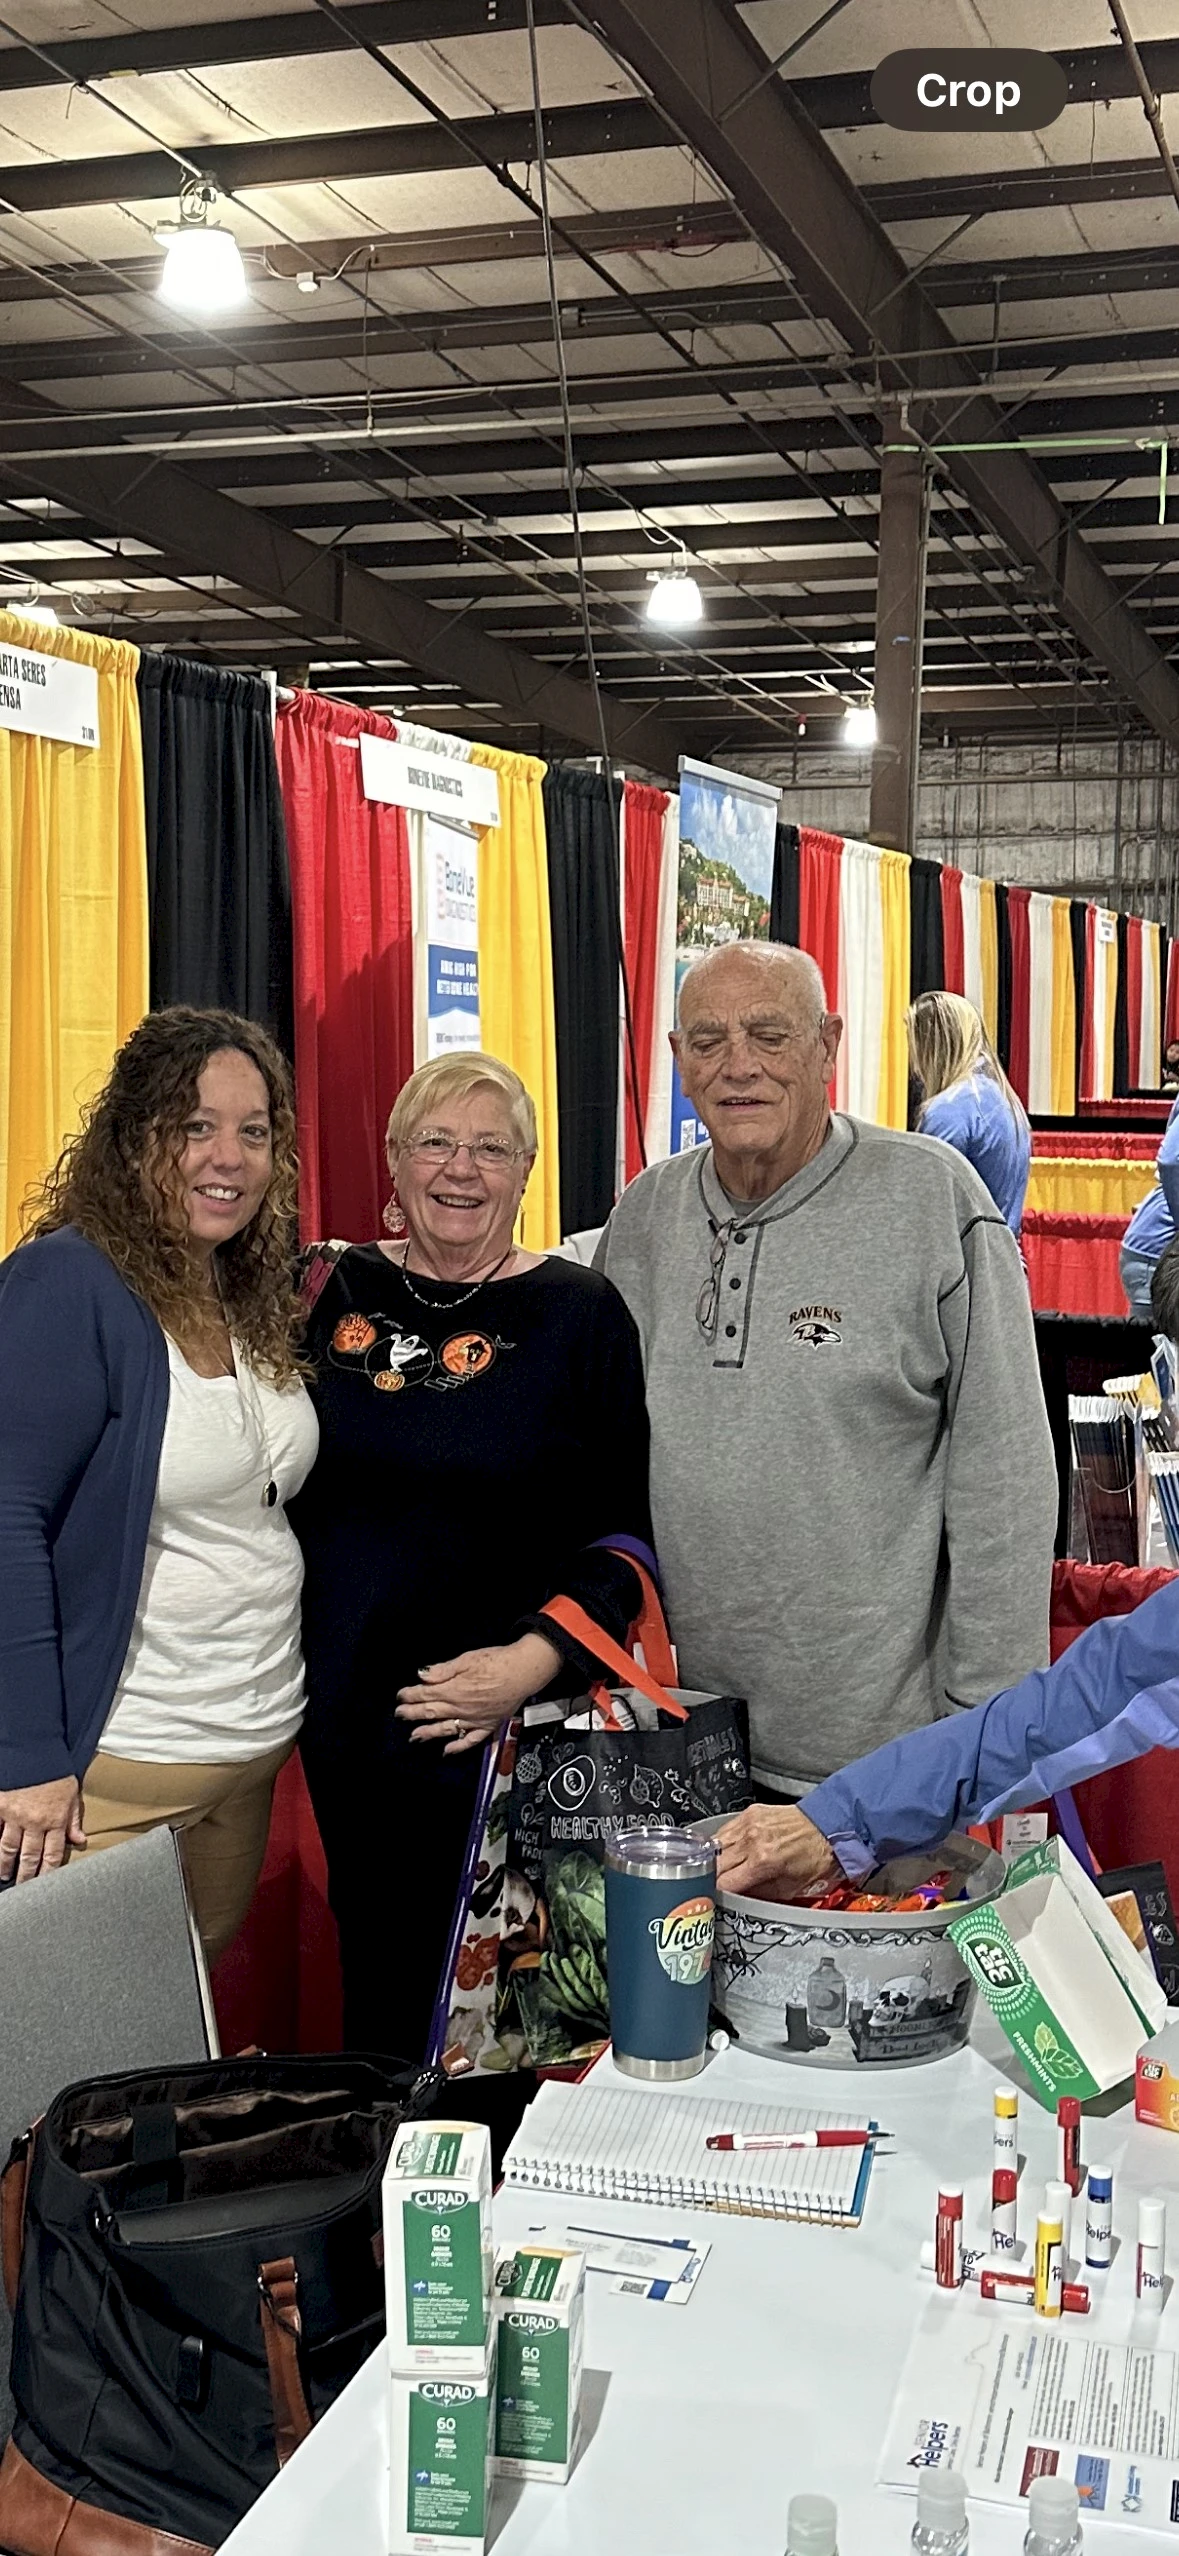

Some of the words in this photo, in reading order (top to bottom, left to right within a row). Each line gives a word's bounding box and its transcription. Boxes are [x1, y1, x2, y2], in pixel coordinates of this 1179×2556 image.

[21, 658, 46, 687] SERES
[789, 1306, 842, 1325] RAVENS
[551, 1815, 624, 1840] HEALTHY
[974, 1942, 1001, 1984] tac
[990, 1946, 1015, 1982] tic
[1012, 2031, 1057, 2093] FRESHMINTS
[414, 2191, 466, 2206] CURAD
[431, 2224, 451, 2239] 60
[508, 2313, 556, 2330] CURAD
[521, 2346, 540, 2360] 60
[421, 2383, 473, 2400] CURAD
[436, 2416, 456, 2431] 60
[919, 2421, 949, 2468] Helpers
